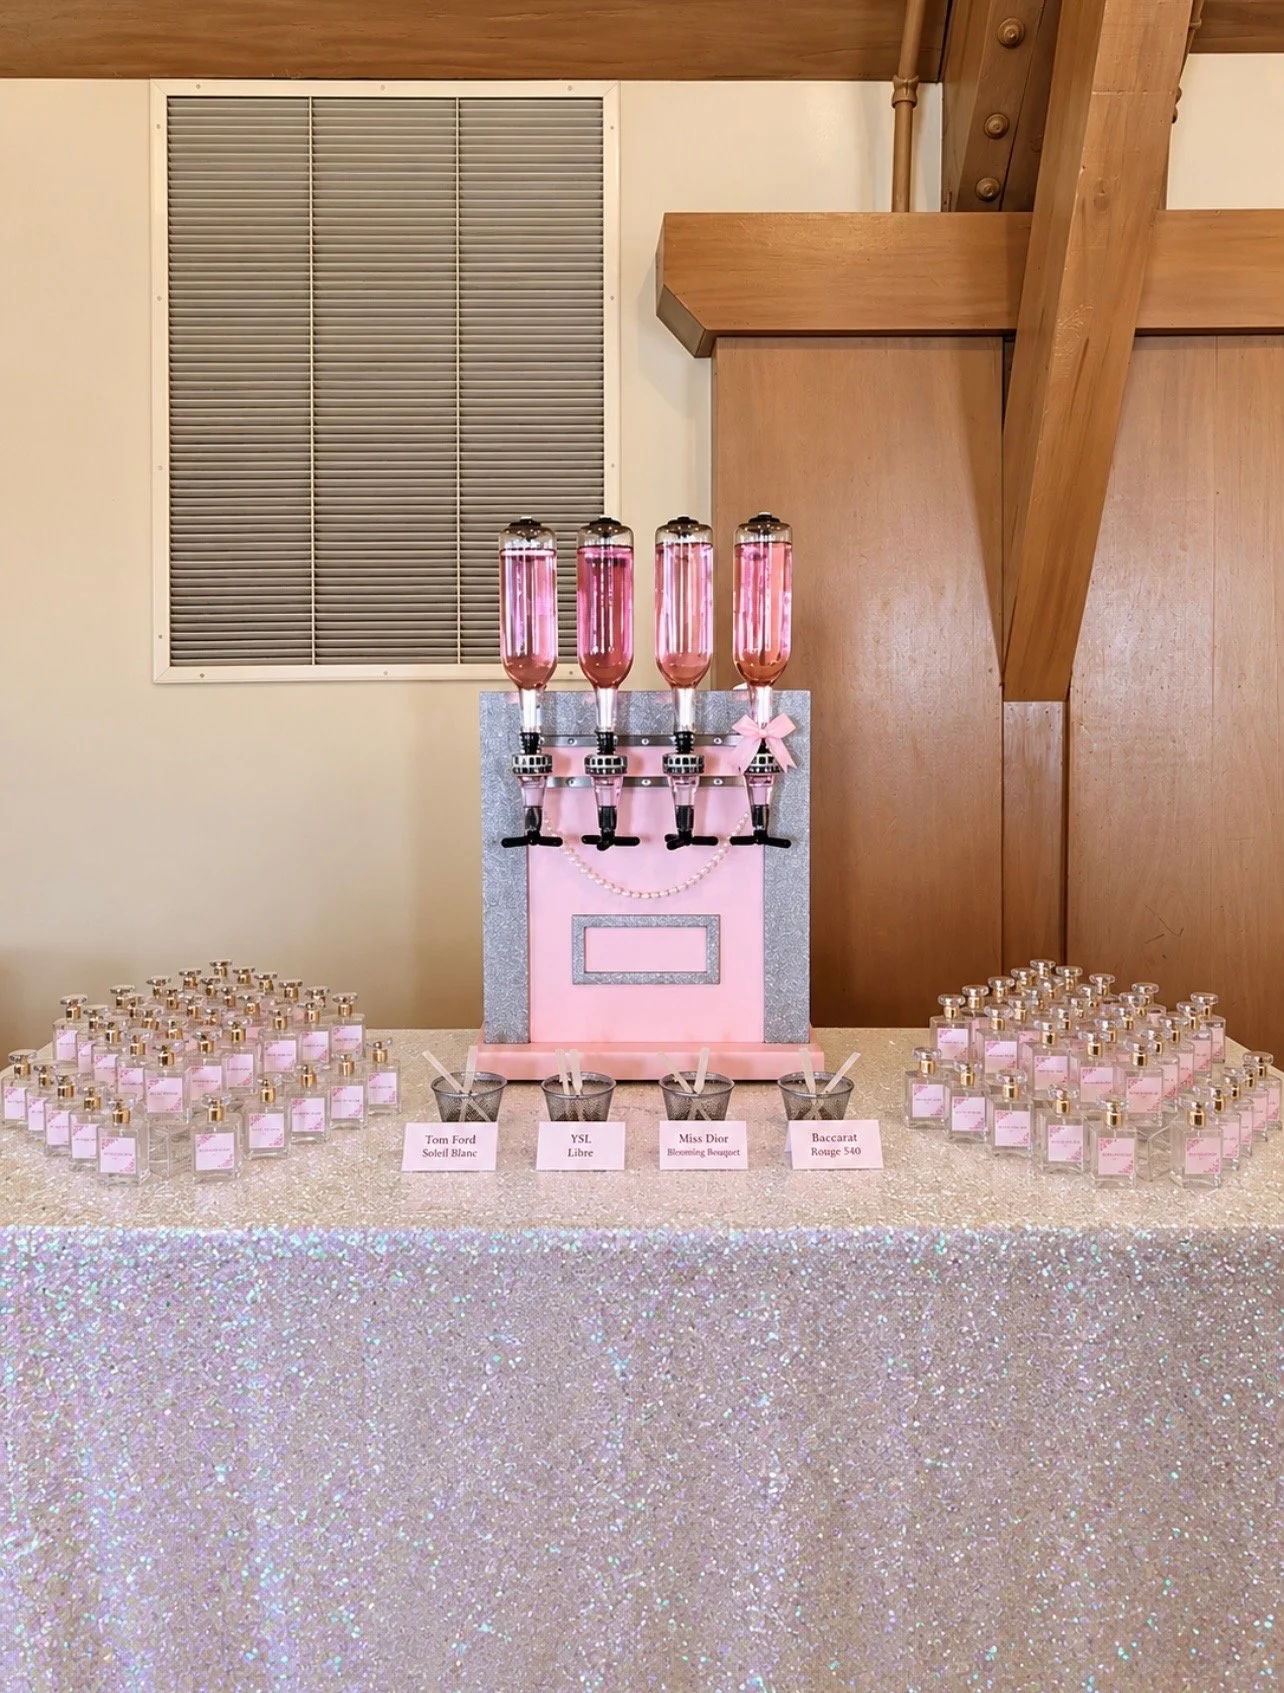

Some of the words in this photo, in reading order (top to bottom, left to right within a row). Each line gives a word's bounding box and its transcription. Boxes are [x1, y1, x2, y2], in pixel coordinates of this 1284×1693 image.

[425, 1134, 449, 1145] Tom
[452, 1134, 476, 1145] Ford
[571, 1133, 591, 1144] YSL
[679, 1133, 703, 1144] Miss
[706, 1133, 729, 1144] Dior
[812, 1132, 857, 1142] Baccarat
[422, 1148, 449, 1158] Soleil
[451, 1148, 478, 1158] Blanc
[567, 1147, 594, 1157] Libre
[667, 1148, 706, 1158] Blooming
[707, 1148, 740, 1158] Bouquet
[811, 1147, 841, 1158] Rouge
[844, 1146, 861, 1156] 540
